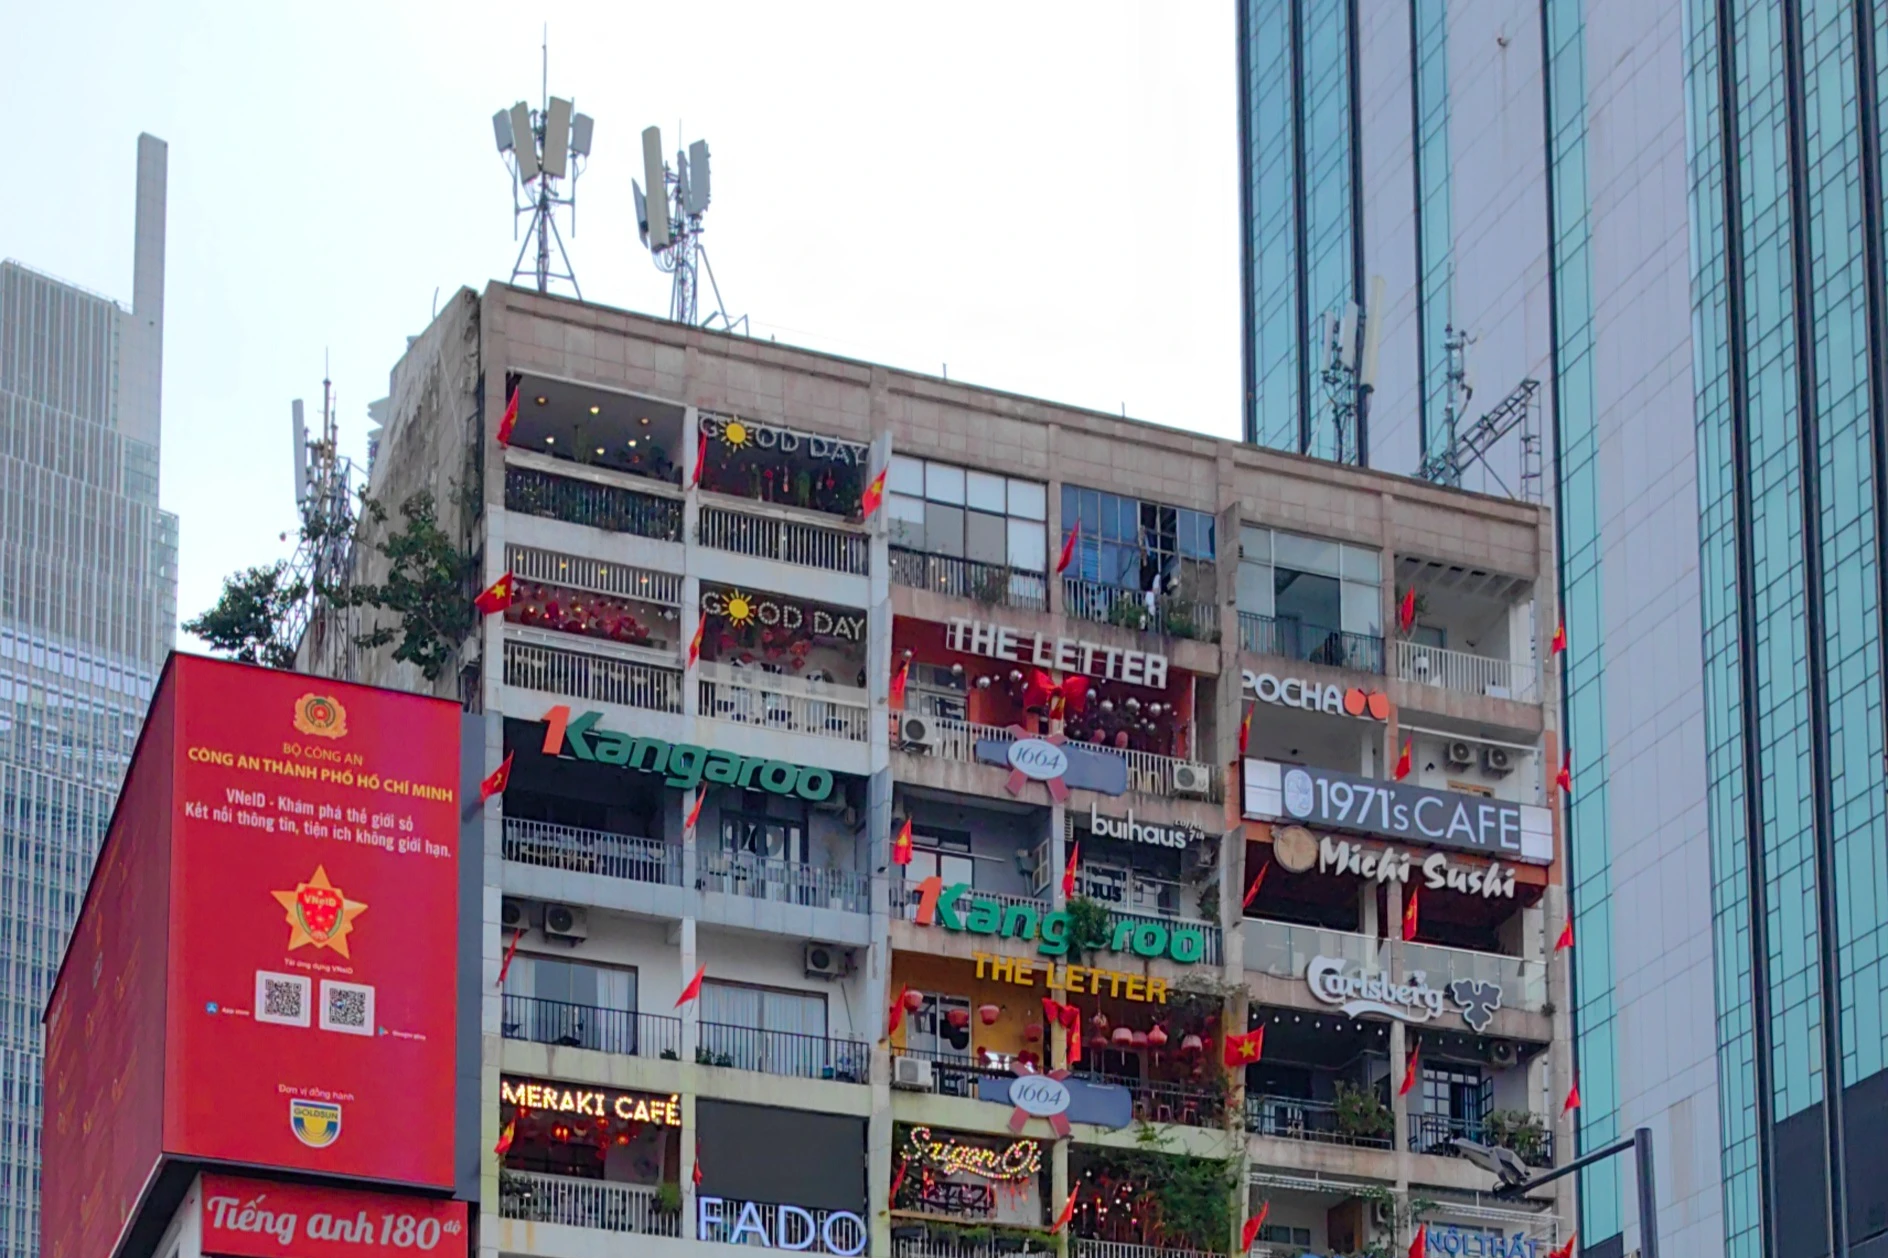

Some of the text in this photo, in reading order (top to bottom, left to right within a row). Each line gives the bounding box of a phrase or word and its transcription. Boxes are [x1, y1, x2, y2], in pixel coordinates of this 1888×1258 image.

[810, 430, 868, 466] DAY
[814, 611, 865, 641] DAY
[946, 617, 1168, 690] THE LETTER
[1241, 668, 1345, 715] POCHA
[188, 746, 234, 767] CÔNG
[237, 755, 260, 771] AN
[262, 758, 318, 780] THÀNH
[321, 767, 354, 785] PHỐ
[383, 779, 409, 795] CHÍ
[412, 783, 453, 802] MINH
[283, 742, 363, 767] BỘ CÔNG AN
[1014, 745, 1062, 770] 1664
[186, 801, 451, 858] Kết nối thông tin, tiện ích không giới hạn.
[226, 787, 414, 832] VNeID Khám phá thế giới số
[1414, 795, 1521, 850] CAFE
[1319, 836, 1515, 899] Michi Sushi
[972, 951, 1168, 1004] THE LETTER
[1306, 955, 1445, 1020] Carlsberg
[294, 1107, 338, 1120] GOLDSUN
[501, 1080, 682, 1127] MERAKI CAFÉ
[1015, 1083, 1063, 1106] 1664
[207, 1194, 297, 1246] Tiếng
[307, 1209, 378, 1245] anh
[380, 1213, 441, 1250] 180
[700, 1196, 868, 1257] FADO
